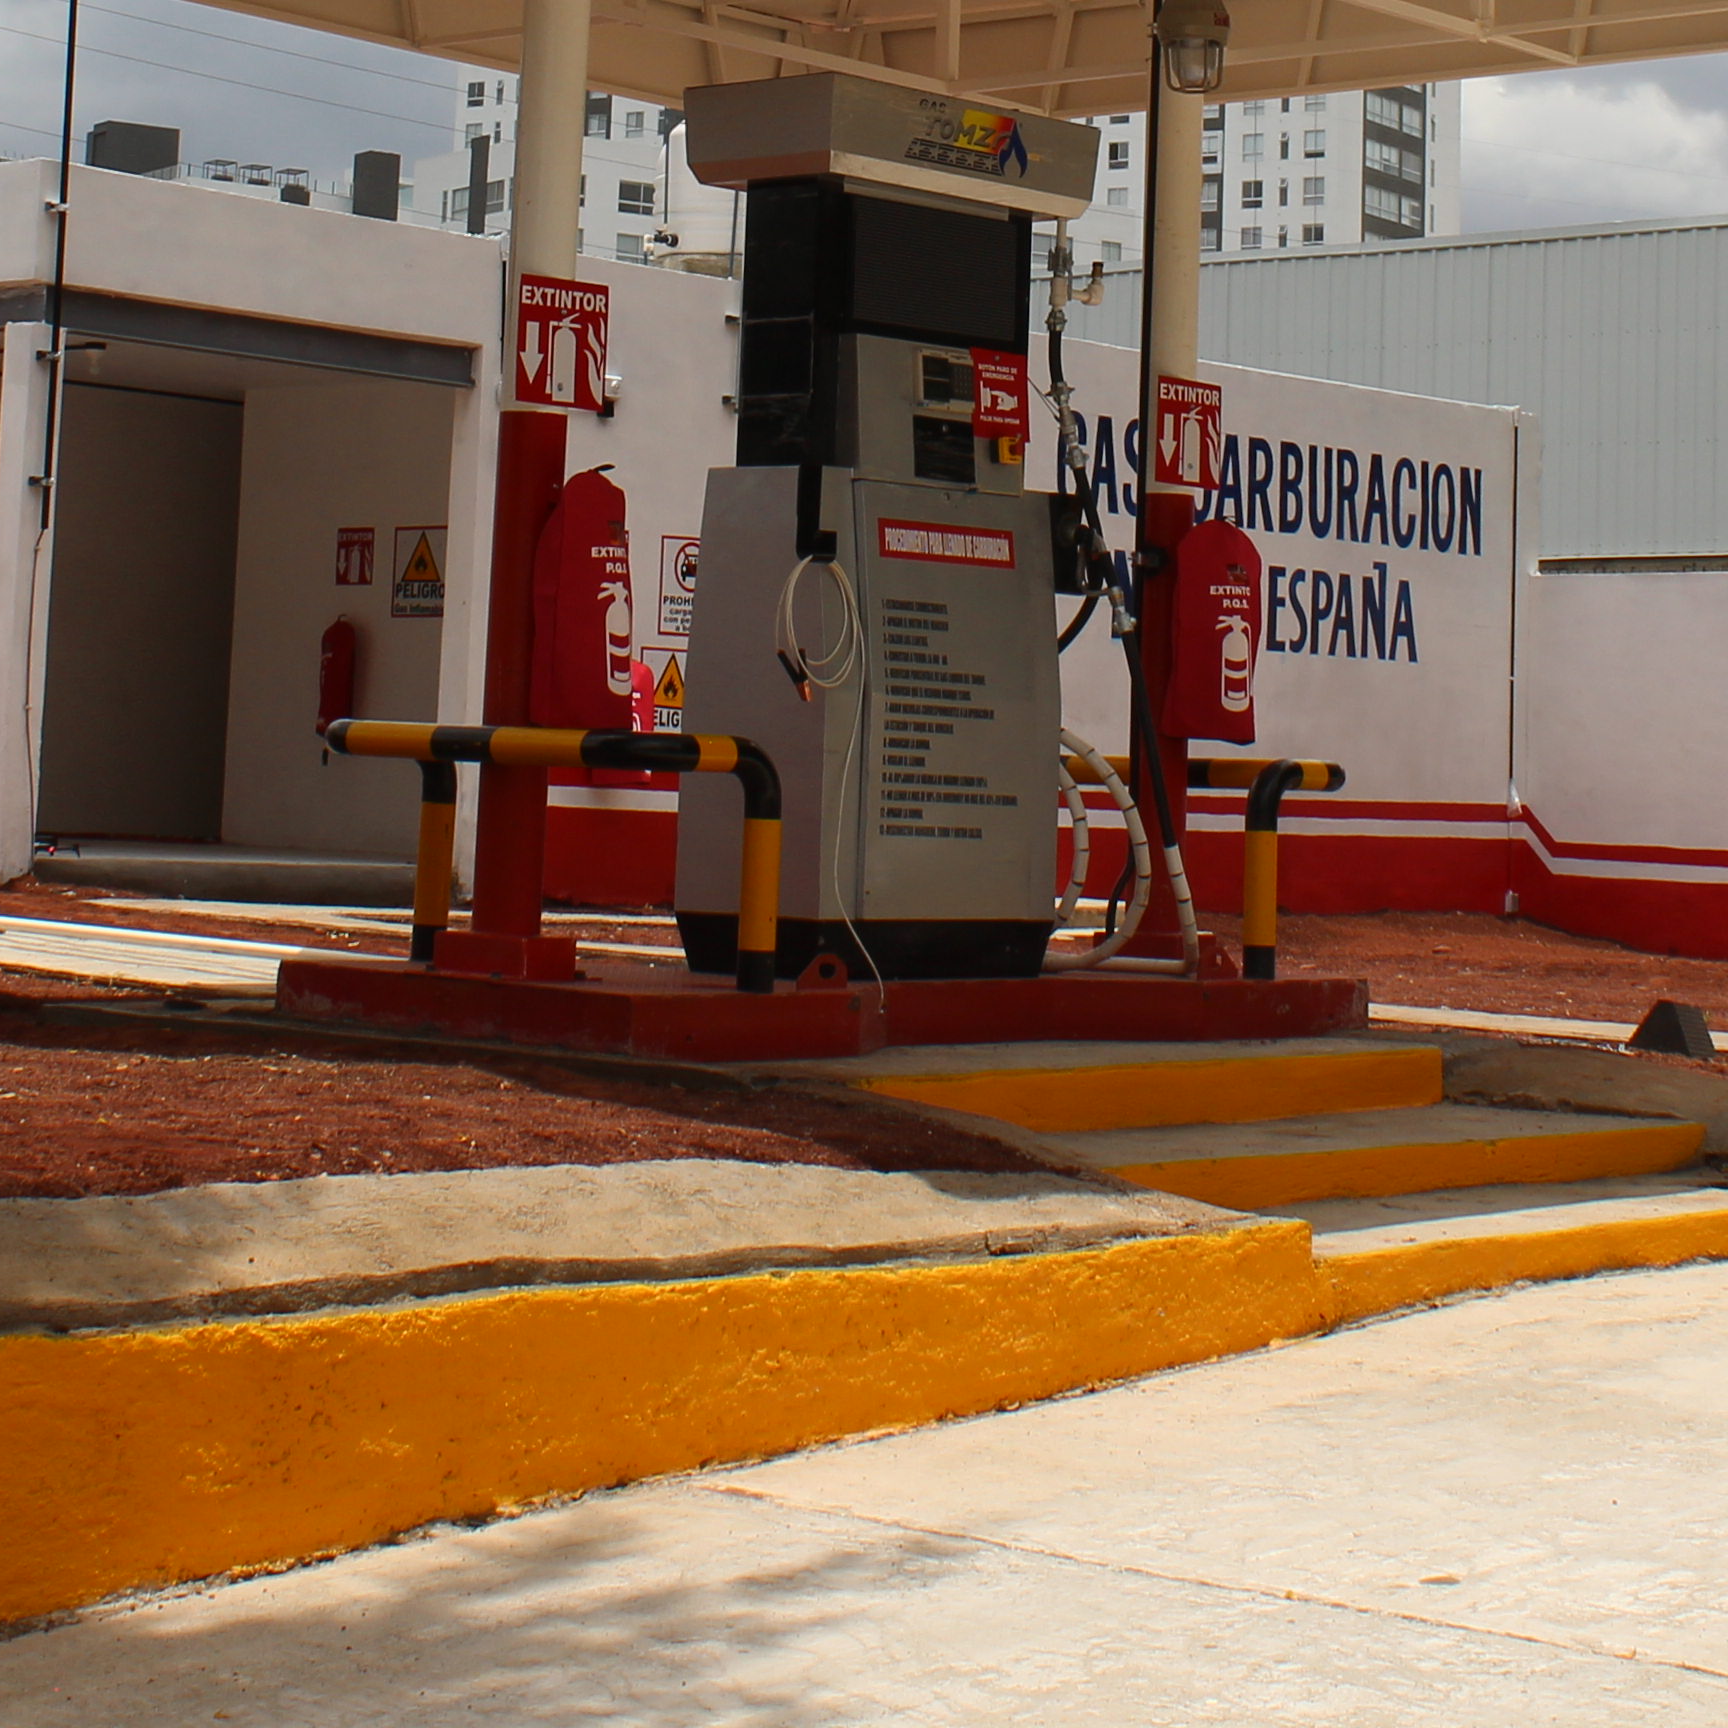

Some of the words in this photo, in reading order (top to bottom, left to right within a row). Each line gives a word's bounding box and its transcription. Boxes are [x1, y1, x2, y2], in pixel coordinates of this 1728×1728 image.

[919, 98, 946, 114] GAS
[925, 115, 1011, 151] TOMZA
[521, 284, 607, 314] EXTINTOR
[1159, 382, 1220, 406] EXTINTOR
[1193, 434, 1482, 556] ARBURACION
[591, 546, 627, 558] EXTIN
[663, 595, 694, 606] PROHI
[1265, 561, 1418, 663] ESPAÑA
